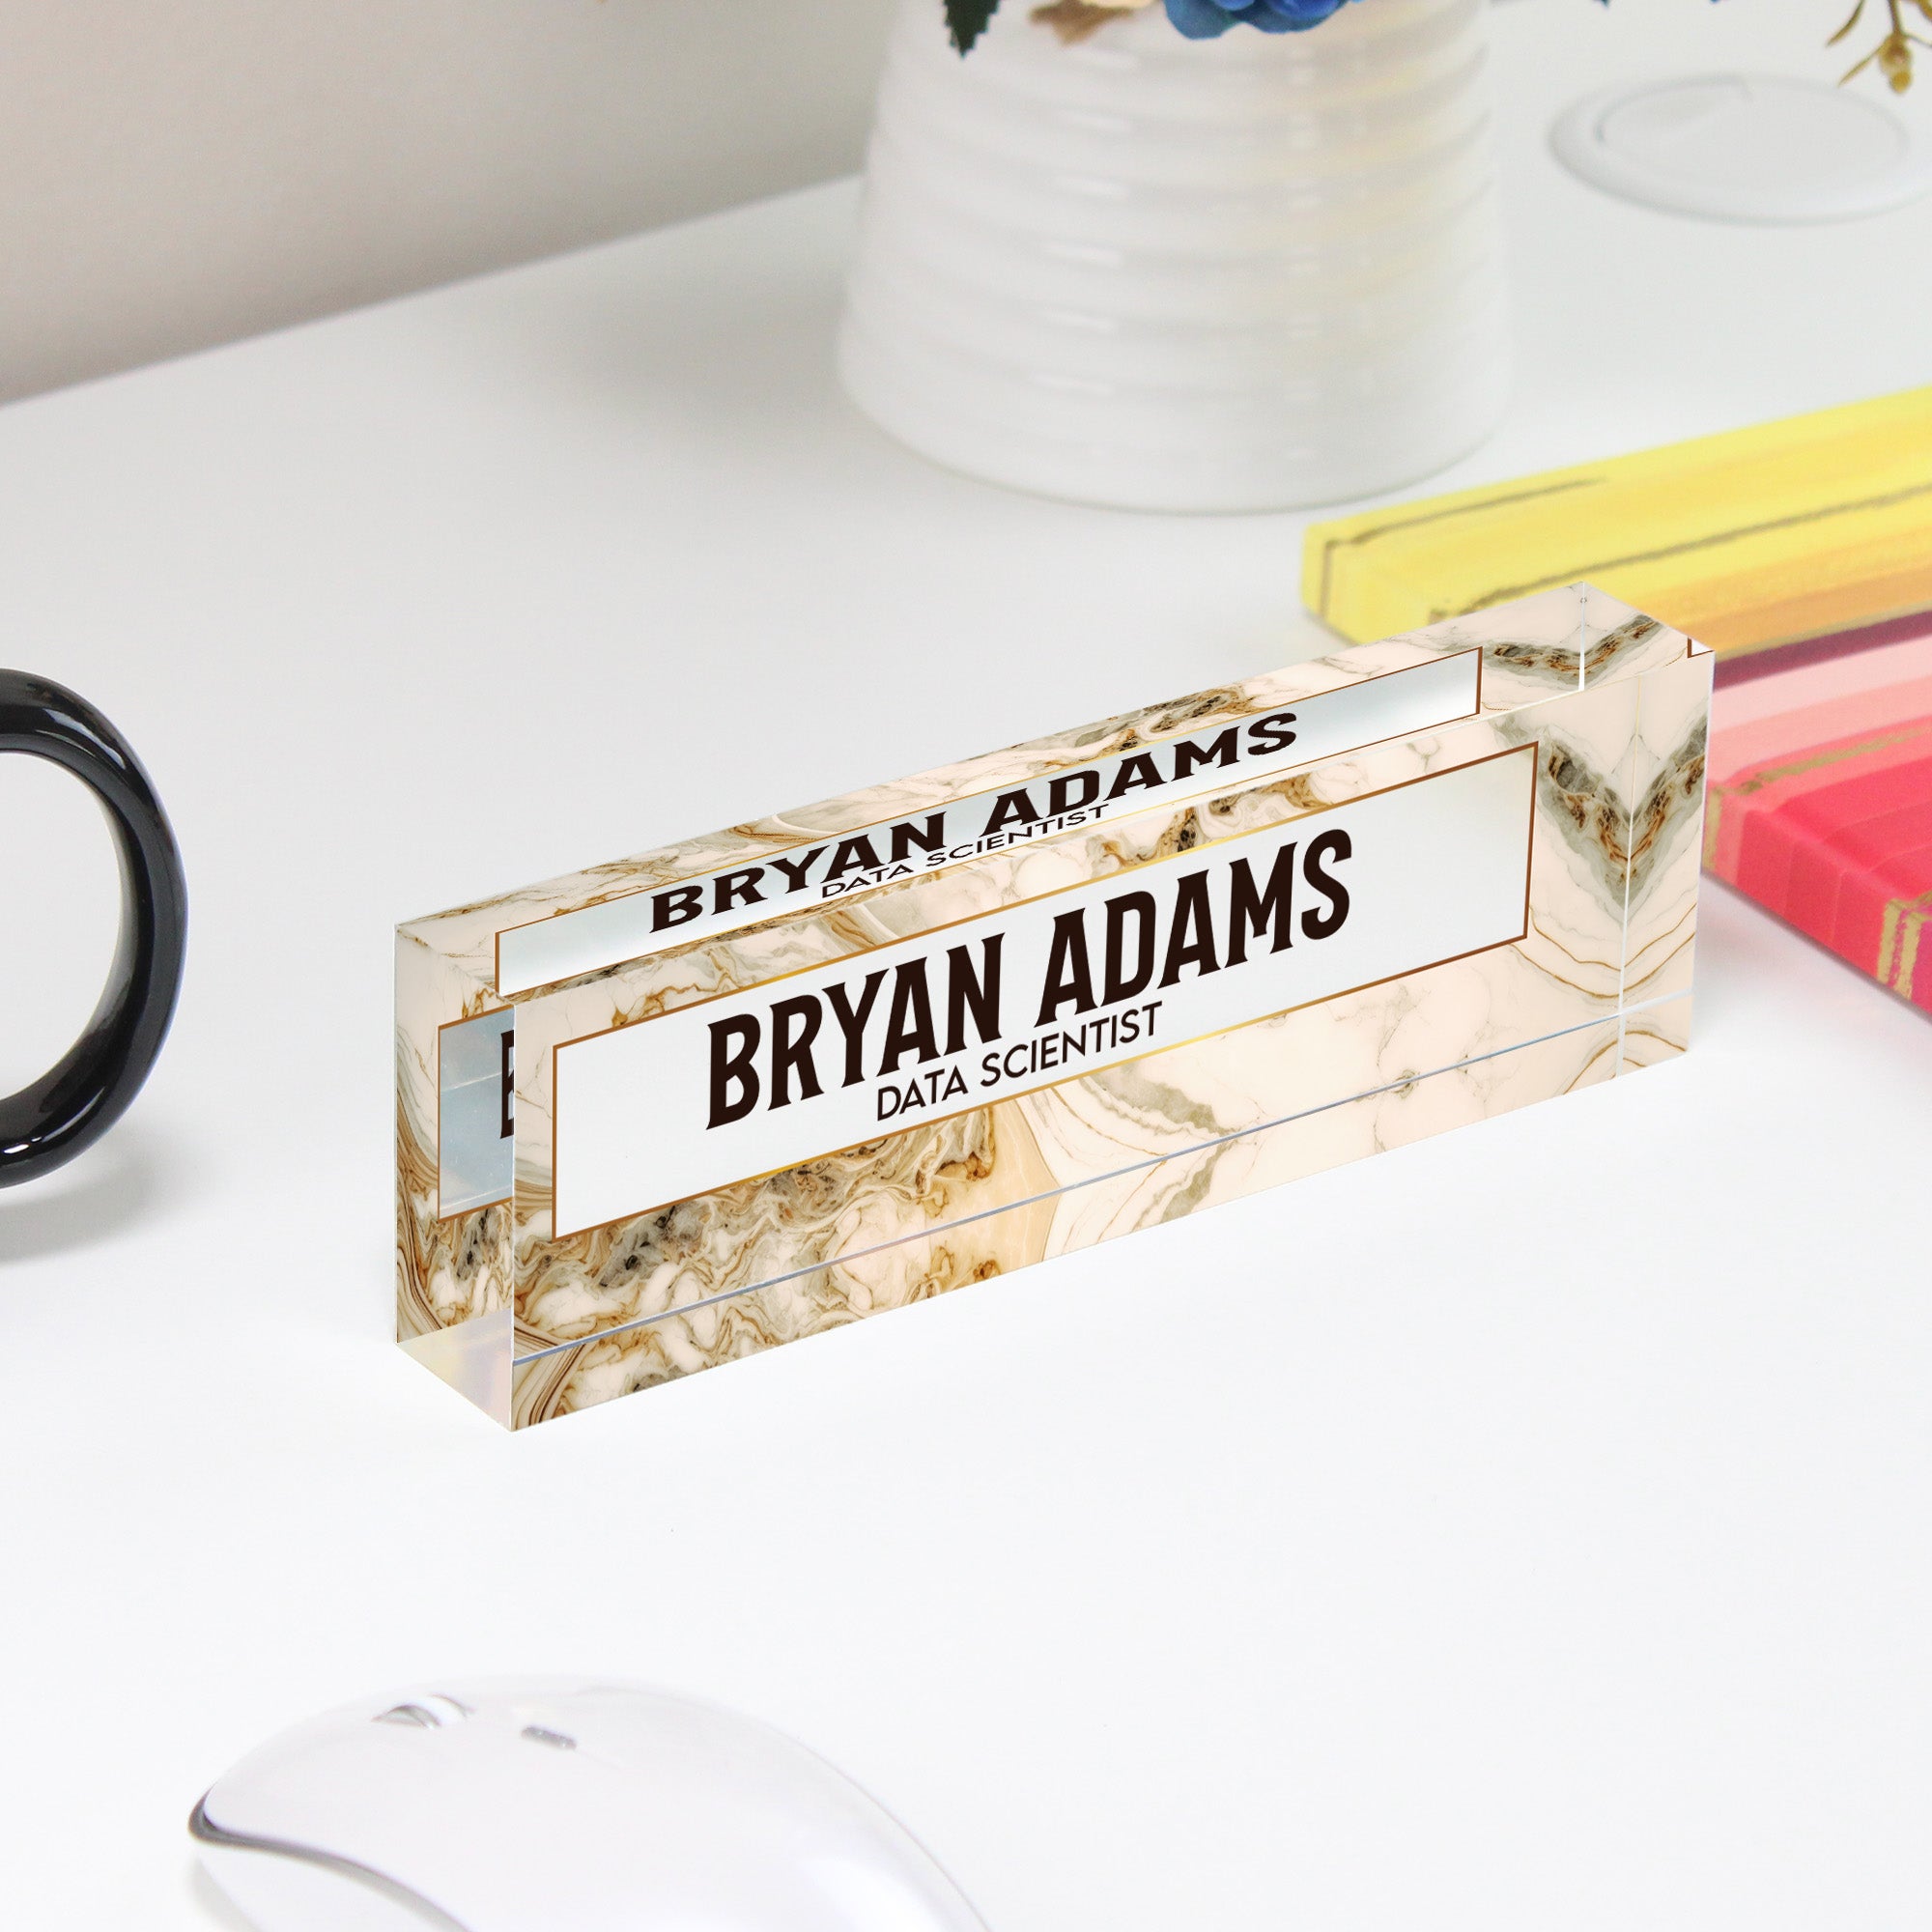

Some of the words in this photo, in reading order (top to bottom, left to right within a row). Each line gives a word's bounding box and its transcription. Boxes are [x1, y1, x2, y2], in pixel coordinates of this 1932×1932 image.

[650, 811, 946, 934] BRYAN
[980, 713, 1296, 838] ADAMS
[822, 864, 914, 898] DATA
[926, 804, 1109, 867] SCIENTIST
[707, 933, 1006, 1130] BRYAN
[1035, 829, 1352, 1028] ADAMS
[877, 1065, 969, 1122] DATA
[980, 1001, 1163, 1104] SCIENTIST
